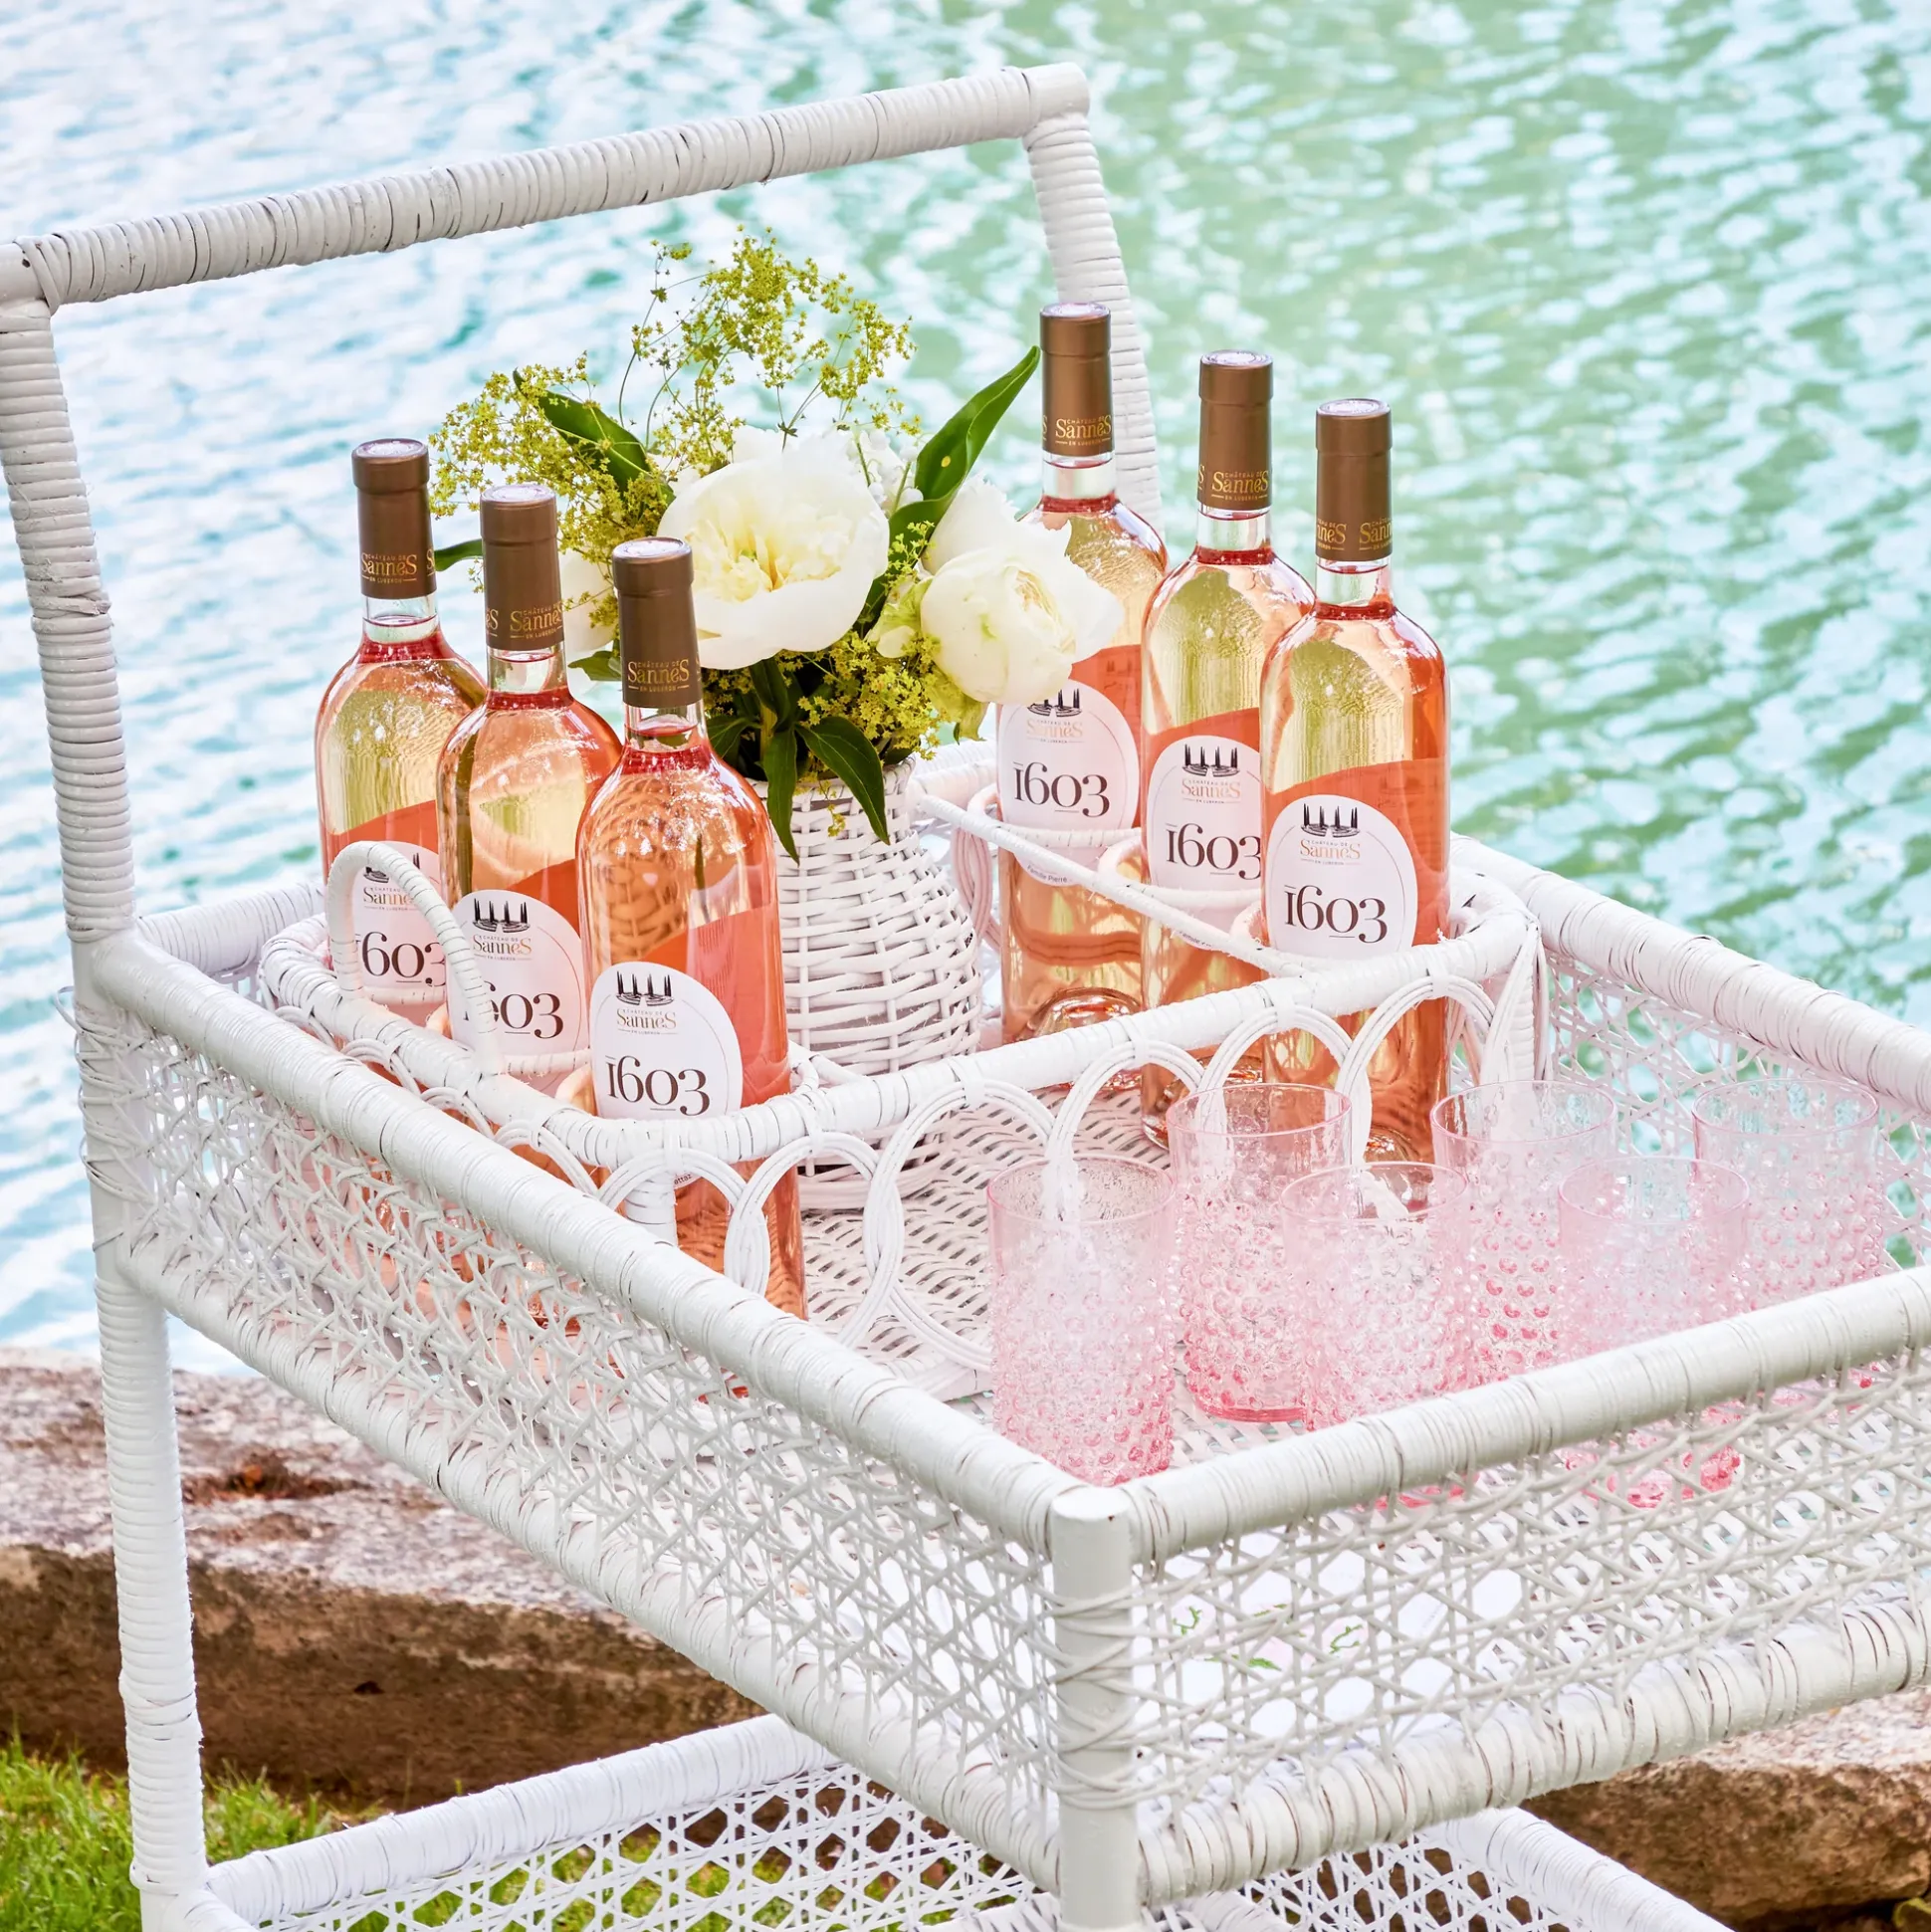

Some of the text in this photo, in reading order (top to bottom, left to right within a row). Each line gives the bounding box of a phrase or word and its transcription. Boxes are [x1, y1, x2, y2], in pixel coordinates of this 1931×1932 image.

[1317, 524, 1347, 544] nneS
[1360, 522, 1392, 543] Sann
[1013, 761, 1110, 818] 1603
[1166, 823, 1261, 880] 1603
[363, 886, 413, 905] Sanne
[1284, 885, 1388, 943] 1603
[355, 932, 446, 986] 603
[463, 980, 563, 1039] 03
[605, 1055, 711, 1117] 1603
[674, 1174, 693, 1184] attaz
